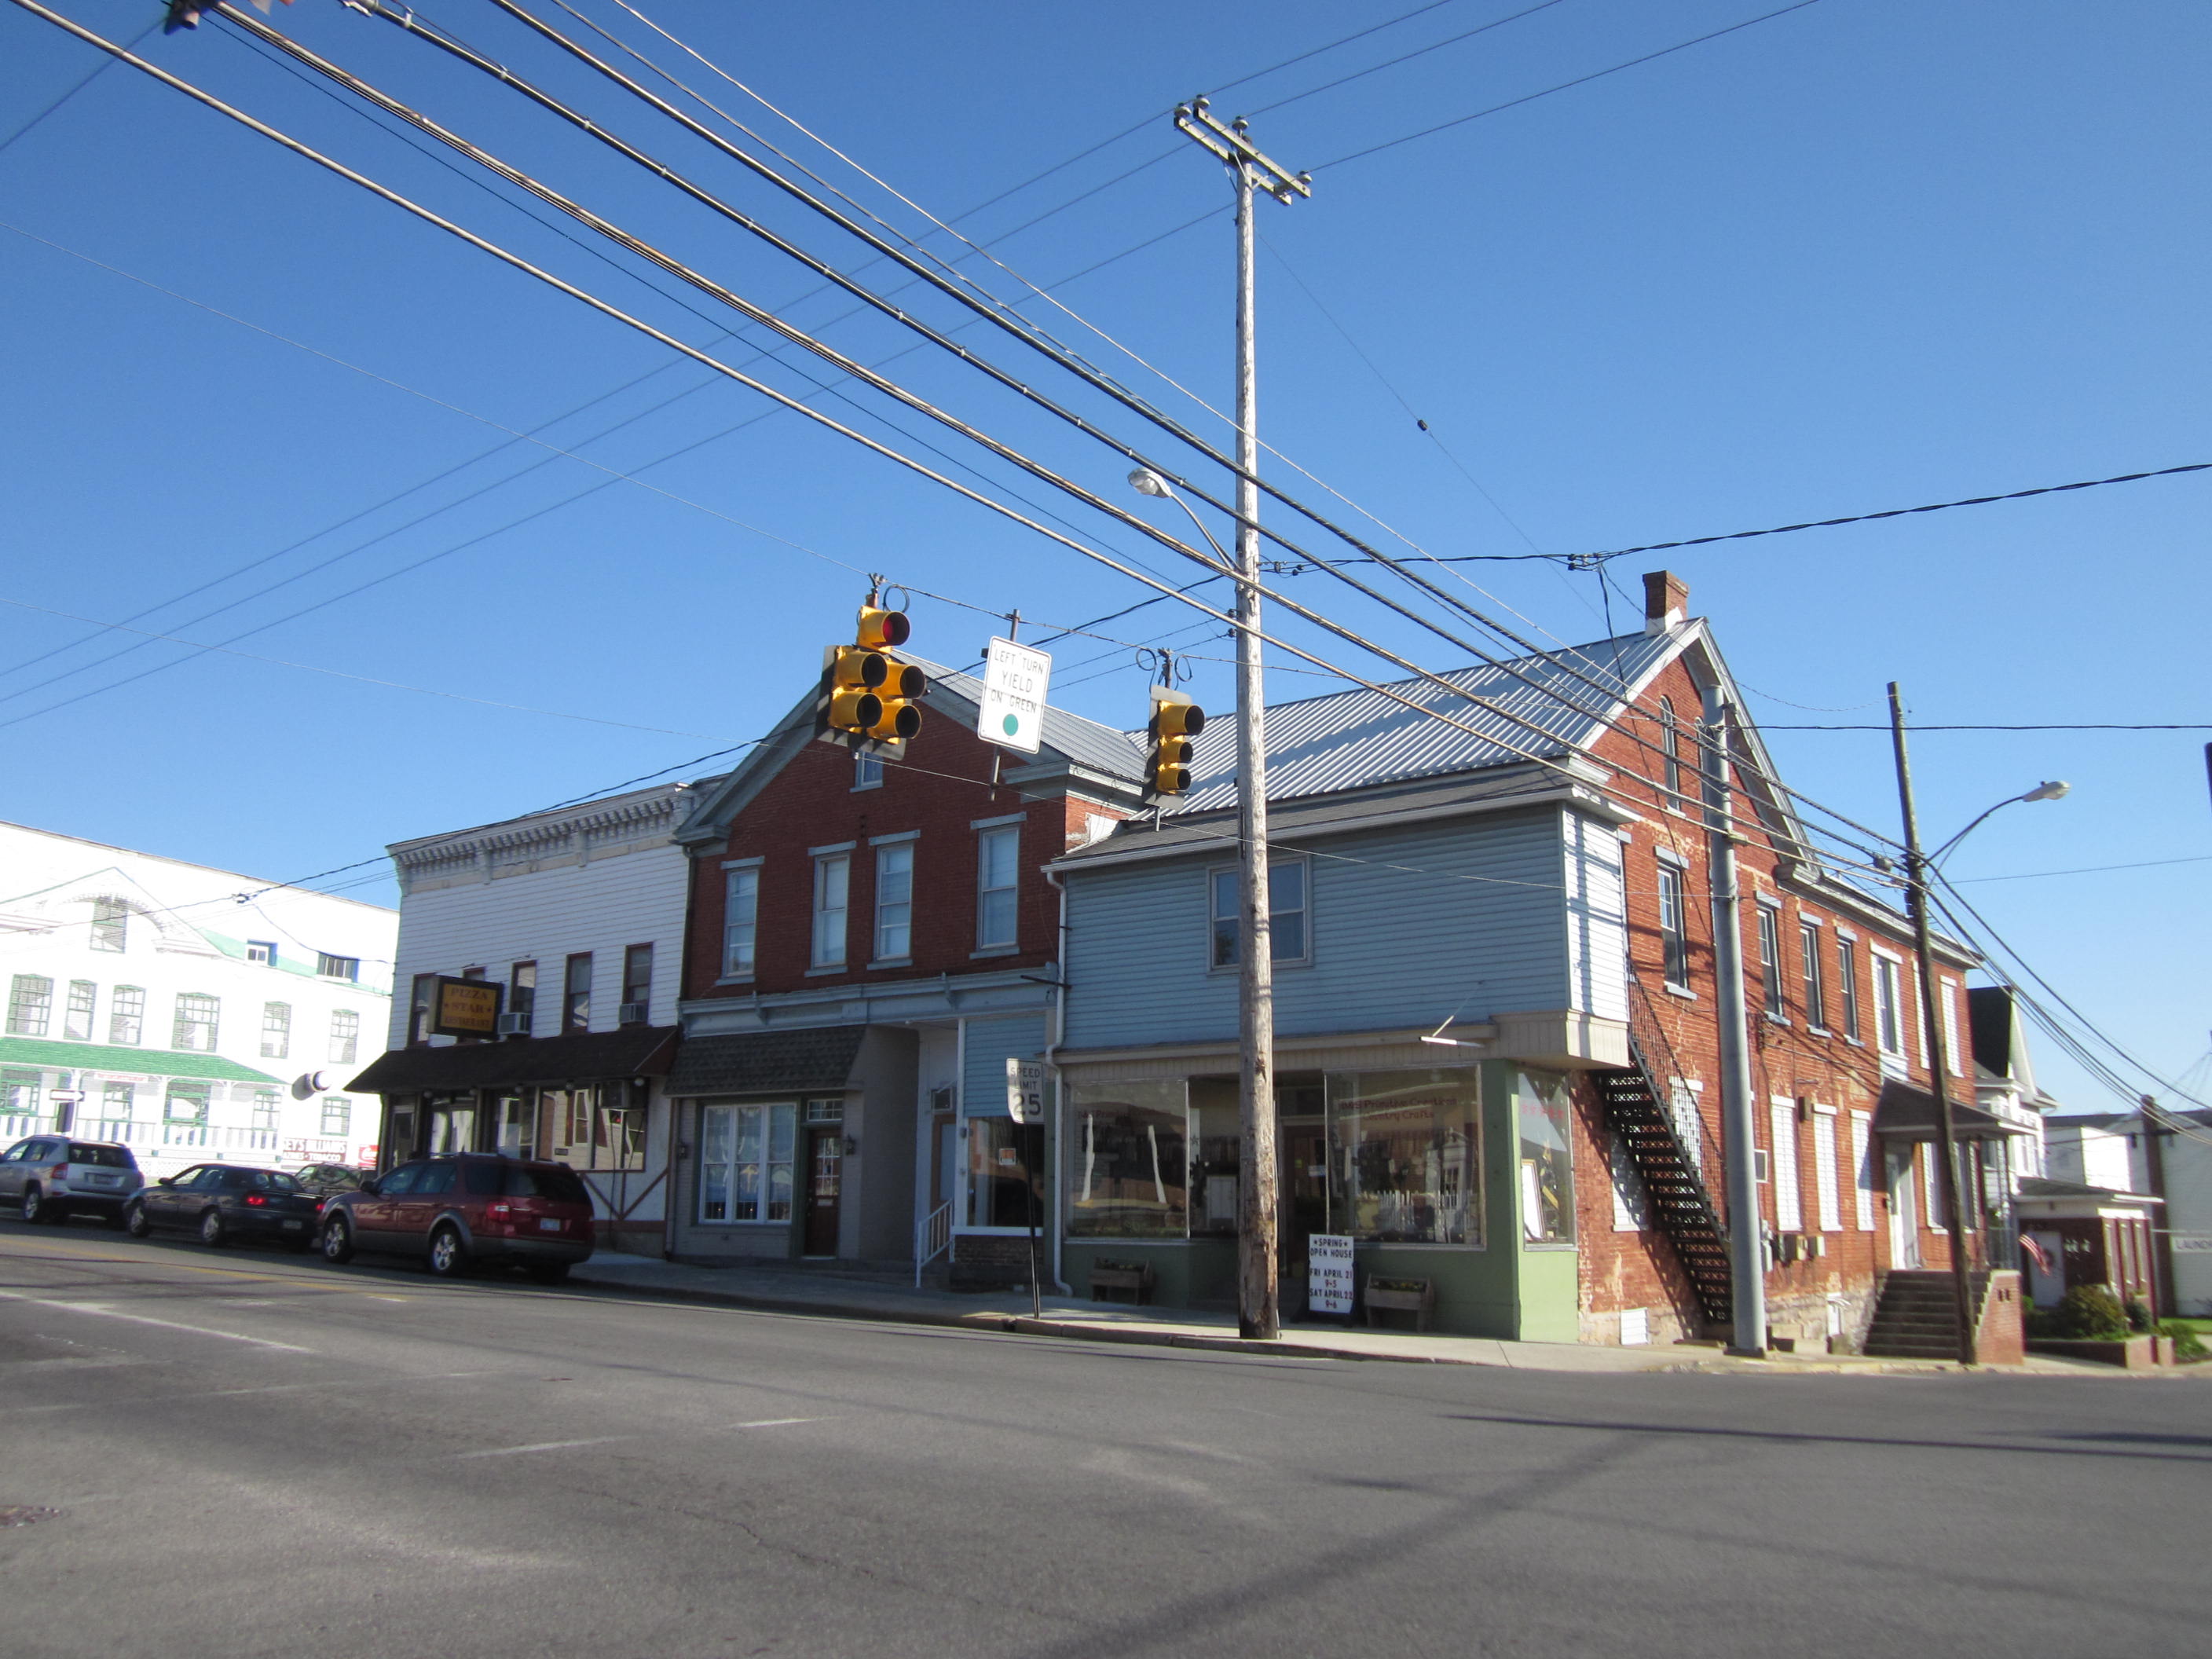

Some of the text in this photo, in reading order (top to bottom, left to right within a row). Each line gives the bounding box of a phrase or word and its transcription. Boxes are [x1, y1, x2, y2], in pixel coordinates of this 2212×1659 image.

[994, 649, 1044, 675] LEFT TURN
[1002, 670, 1033, 693] YIELD
[991, 689, 1037, 714] ON GREEN
[452, 987, 487, 1000] PIZZA
[452, 1002, 484, 1013] STAR
[1010, 1067, 1040, 1078] SPEED
[1014, 1080, 1037, 1090] LIMIT
[1013, 1093, 1041, 1115] 25
[1319, 1238, 1342, 1247] SPRING
[1309, 1248, 1353, 1258] OPEN HOUSE
[1309, 1268, 1320, 1276] FRI
[1324, 1269, 1343, 1278] APRIL
[1309, 1288, 1353, 1300] SAT APRIL 22
